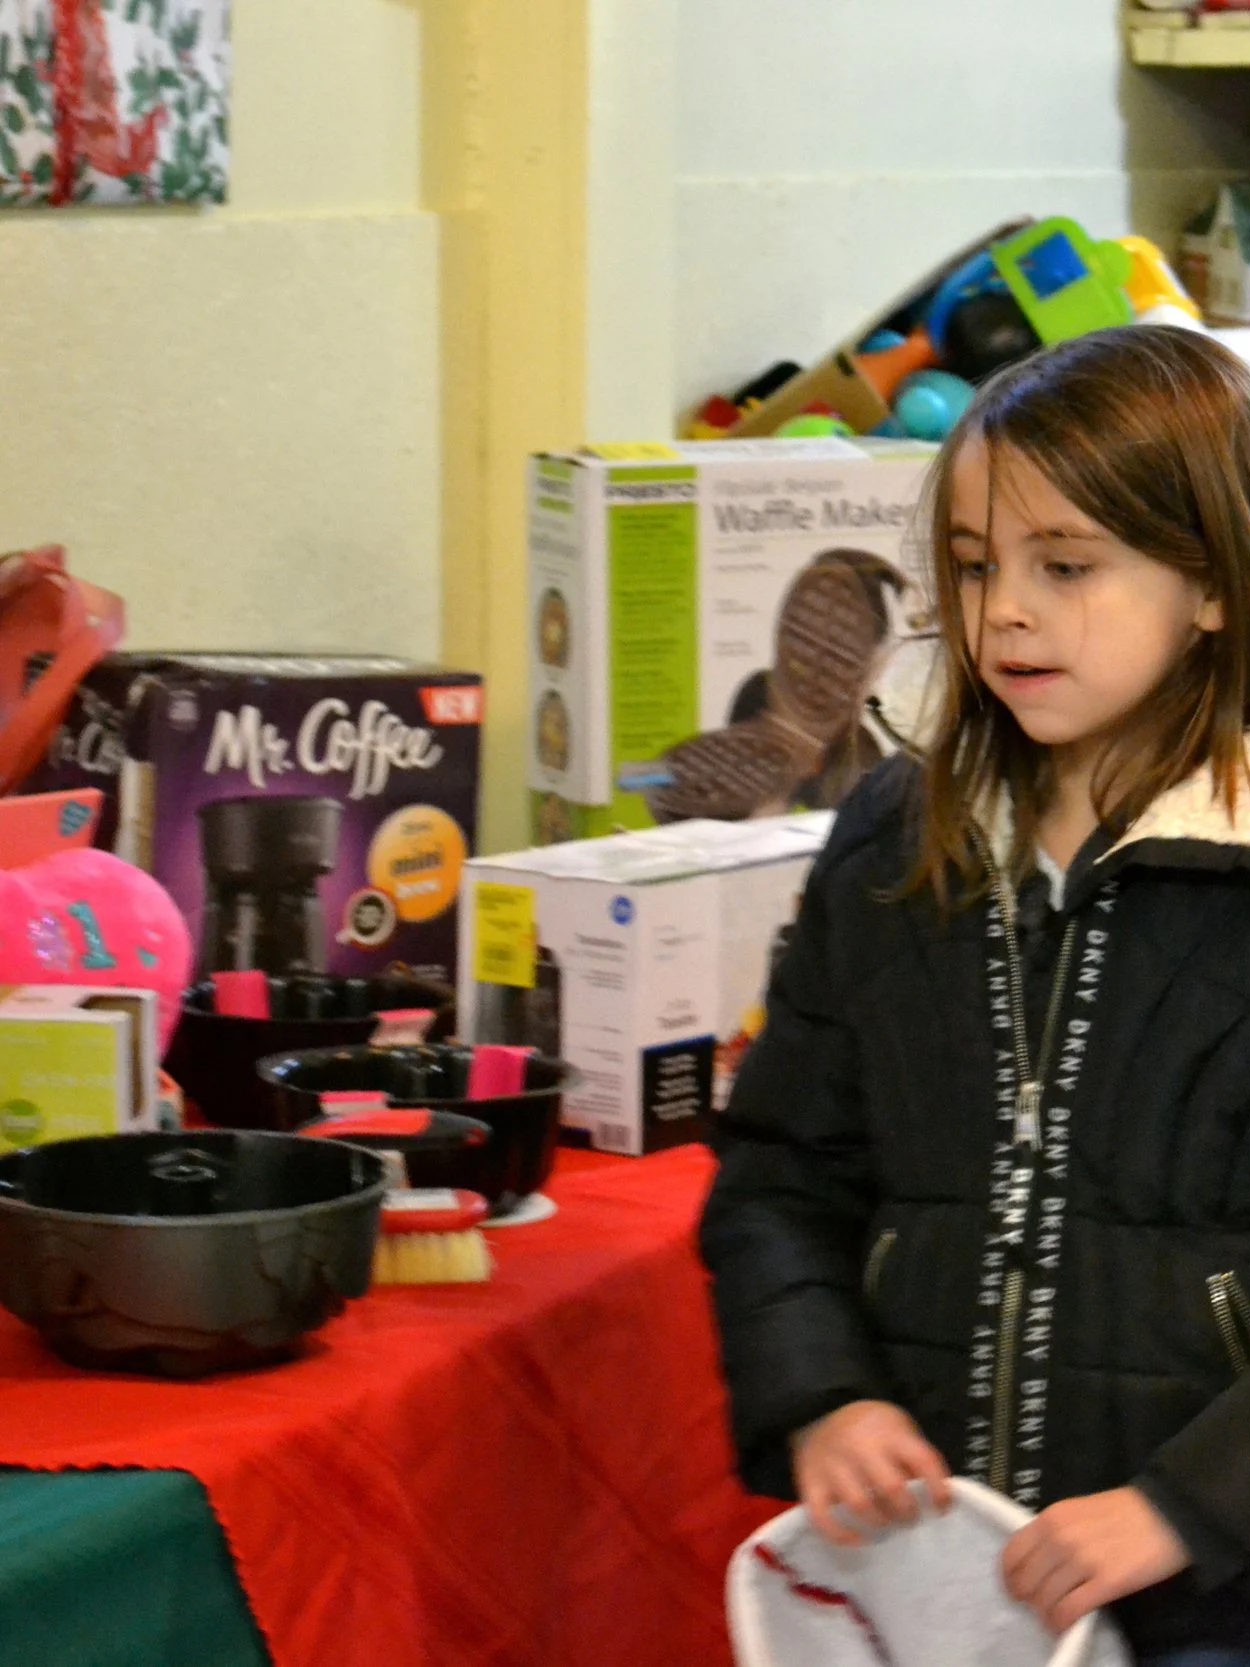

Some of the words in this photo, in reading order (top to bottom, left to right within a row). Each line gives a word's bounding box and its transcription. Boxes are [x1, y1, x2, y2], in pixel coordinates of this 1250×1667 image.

[713, 498, 814, 533] Waffle
[204, 704, 294, 789] Mr.
[300, 697, 444, 800] Coffee
[985, 956, 1014, 1030] DKNY
[1074, 928, 1110, 1004] DKNY
[1053, 1018, 1093, 1093] DKNY
[1042, 1106, 1073, 1180] DKNY
[1001, 1167, 1035, 1246] DKNY
[1034, 1196, 1068, 1270] DKNY
[977, 1231, 1006, 1307] DKNY
[965, 1324, 997, 1399] DKNY
[1020, 1286, 1057, 1362] DKNY
[1014, 1378, 1049, 1451] DKNY
